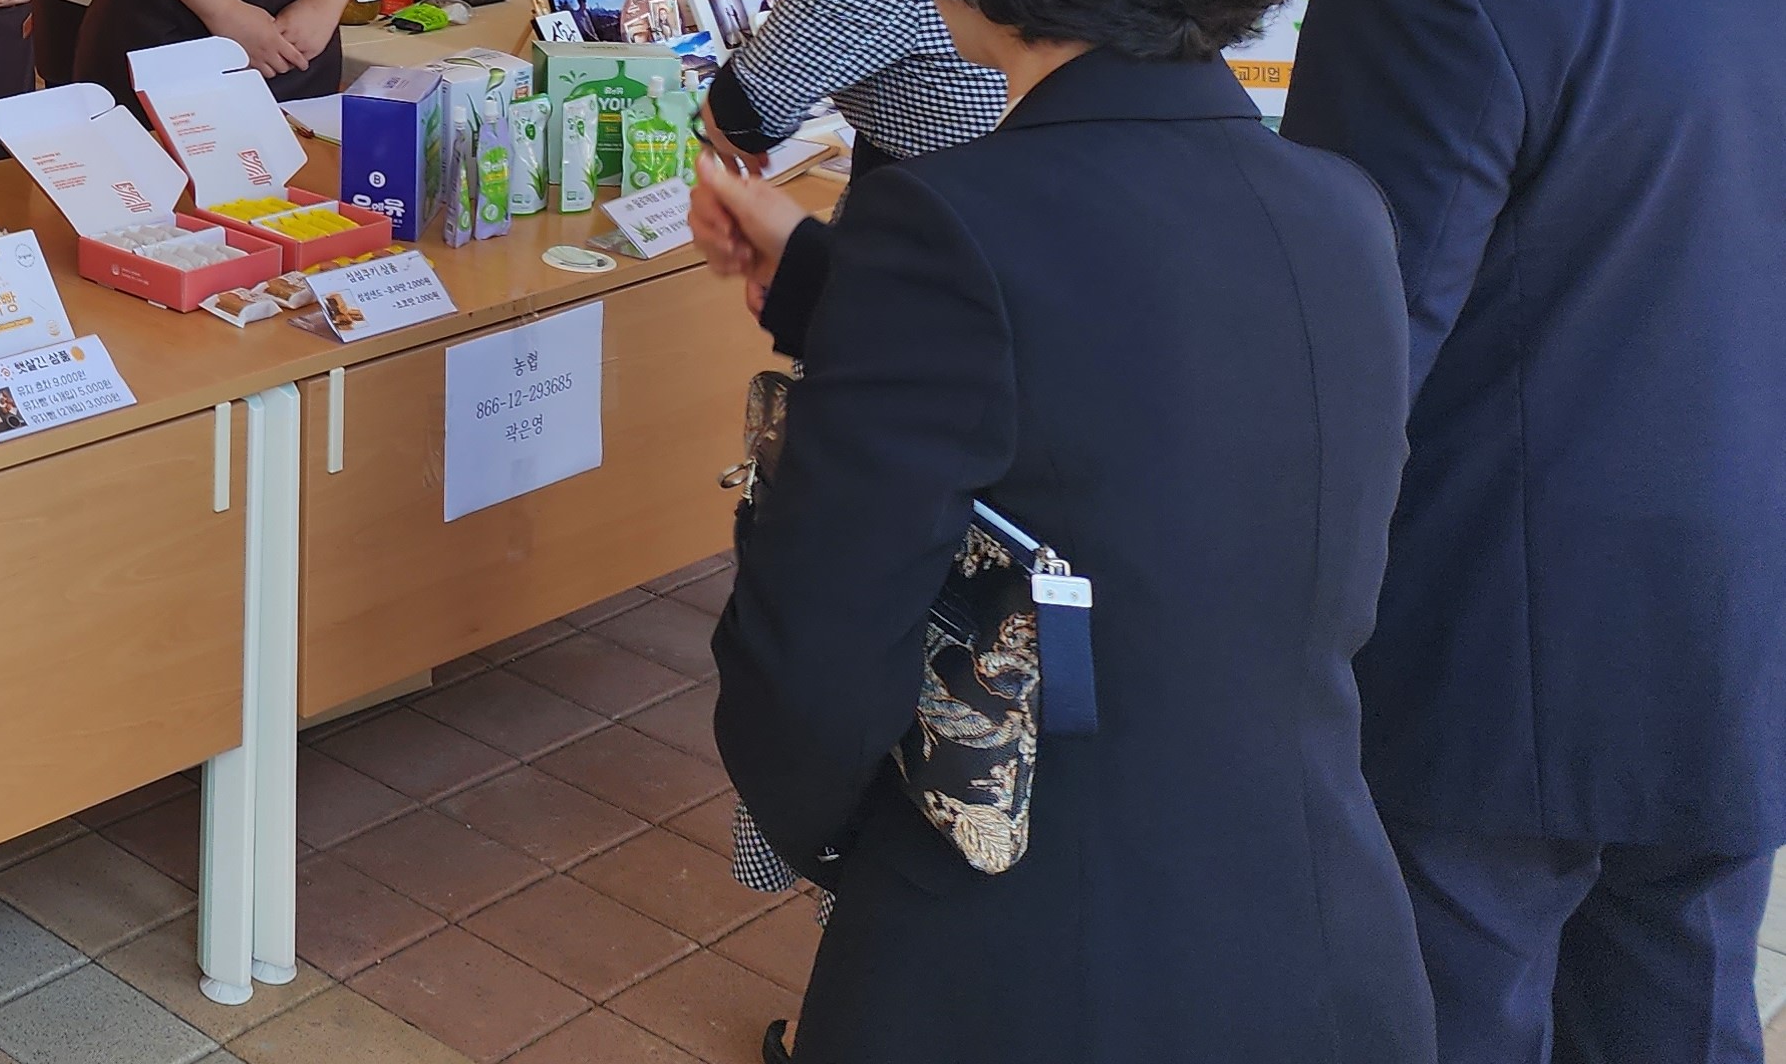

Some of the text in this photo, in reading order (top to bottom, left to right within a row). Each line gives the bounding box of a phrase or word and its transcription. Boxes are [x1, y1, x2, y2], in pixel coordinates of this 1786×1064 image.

[1231, 66, 1281, 83] 교기업
[380, 262, 399, 276] 상품
[512, 350, 539, 377] 농협
[16, 384, 35, 397] 유자
[54, 369, 87, 388] 9,000원
[22, 396, 48, 412] 유자빵
[79, 378, 113, 397] 5,000원
[476, 372, 573, 420] 866-12-293685
[30, 410, 58, 425] 유자빵
[87, 392, 121, 410] 3,000원
[505, 413, 544, 442] 곽은영
